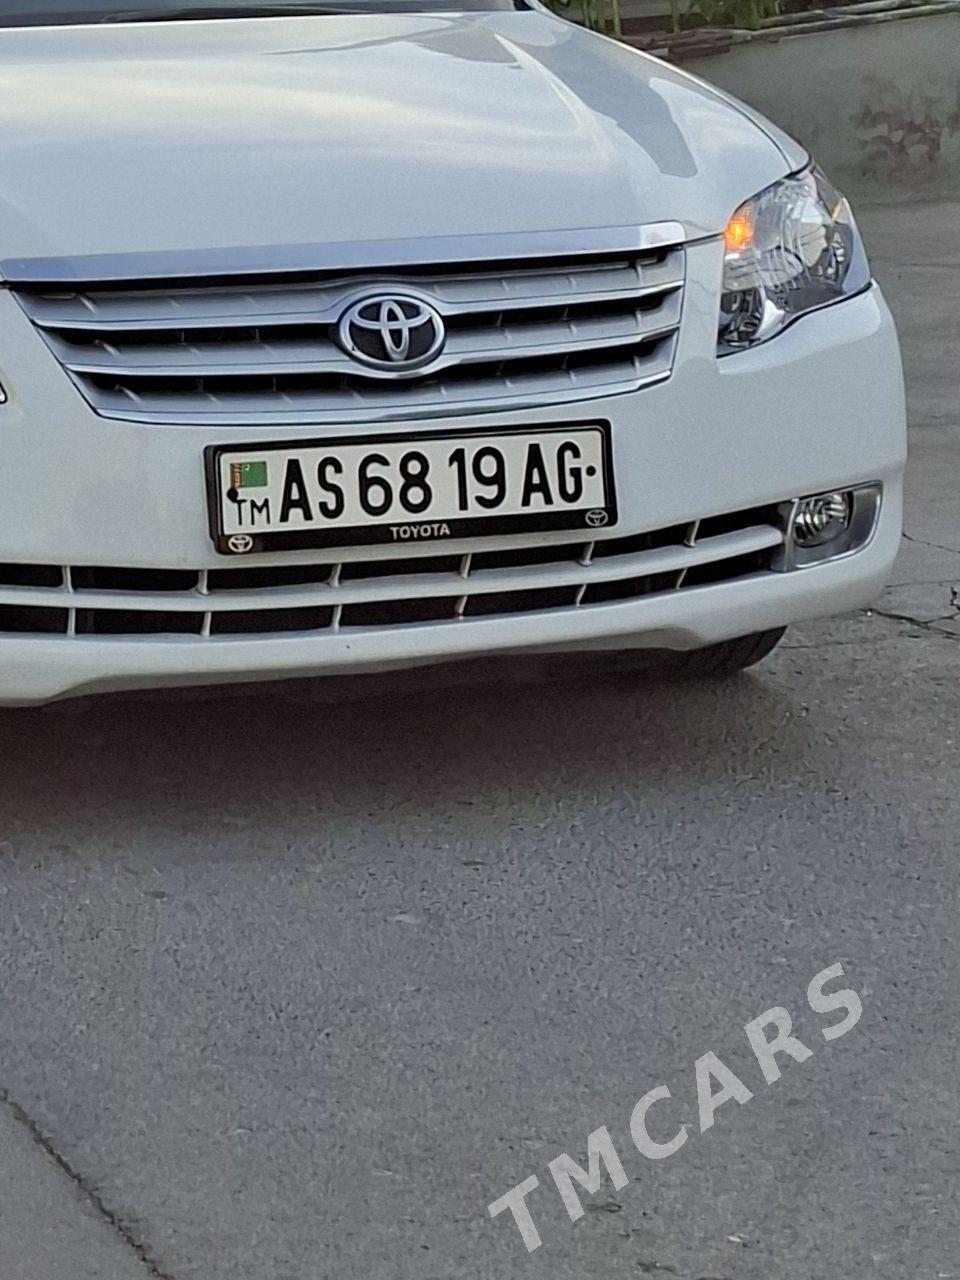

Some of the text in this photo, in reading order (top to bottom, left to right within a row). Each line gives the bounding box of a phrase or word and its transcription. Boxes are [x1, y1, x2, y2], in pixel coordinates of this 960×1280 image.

[279, 441, 583, 523] AS 68 19 AG
[231, 497, 271, 526] TM
[389, 523, 451, 540] TOYOTA
